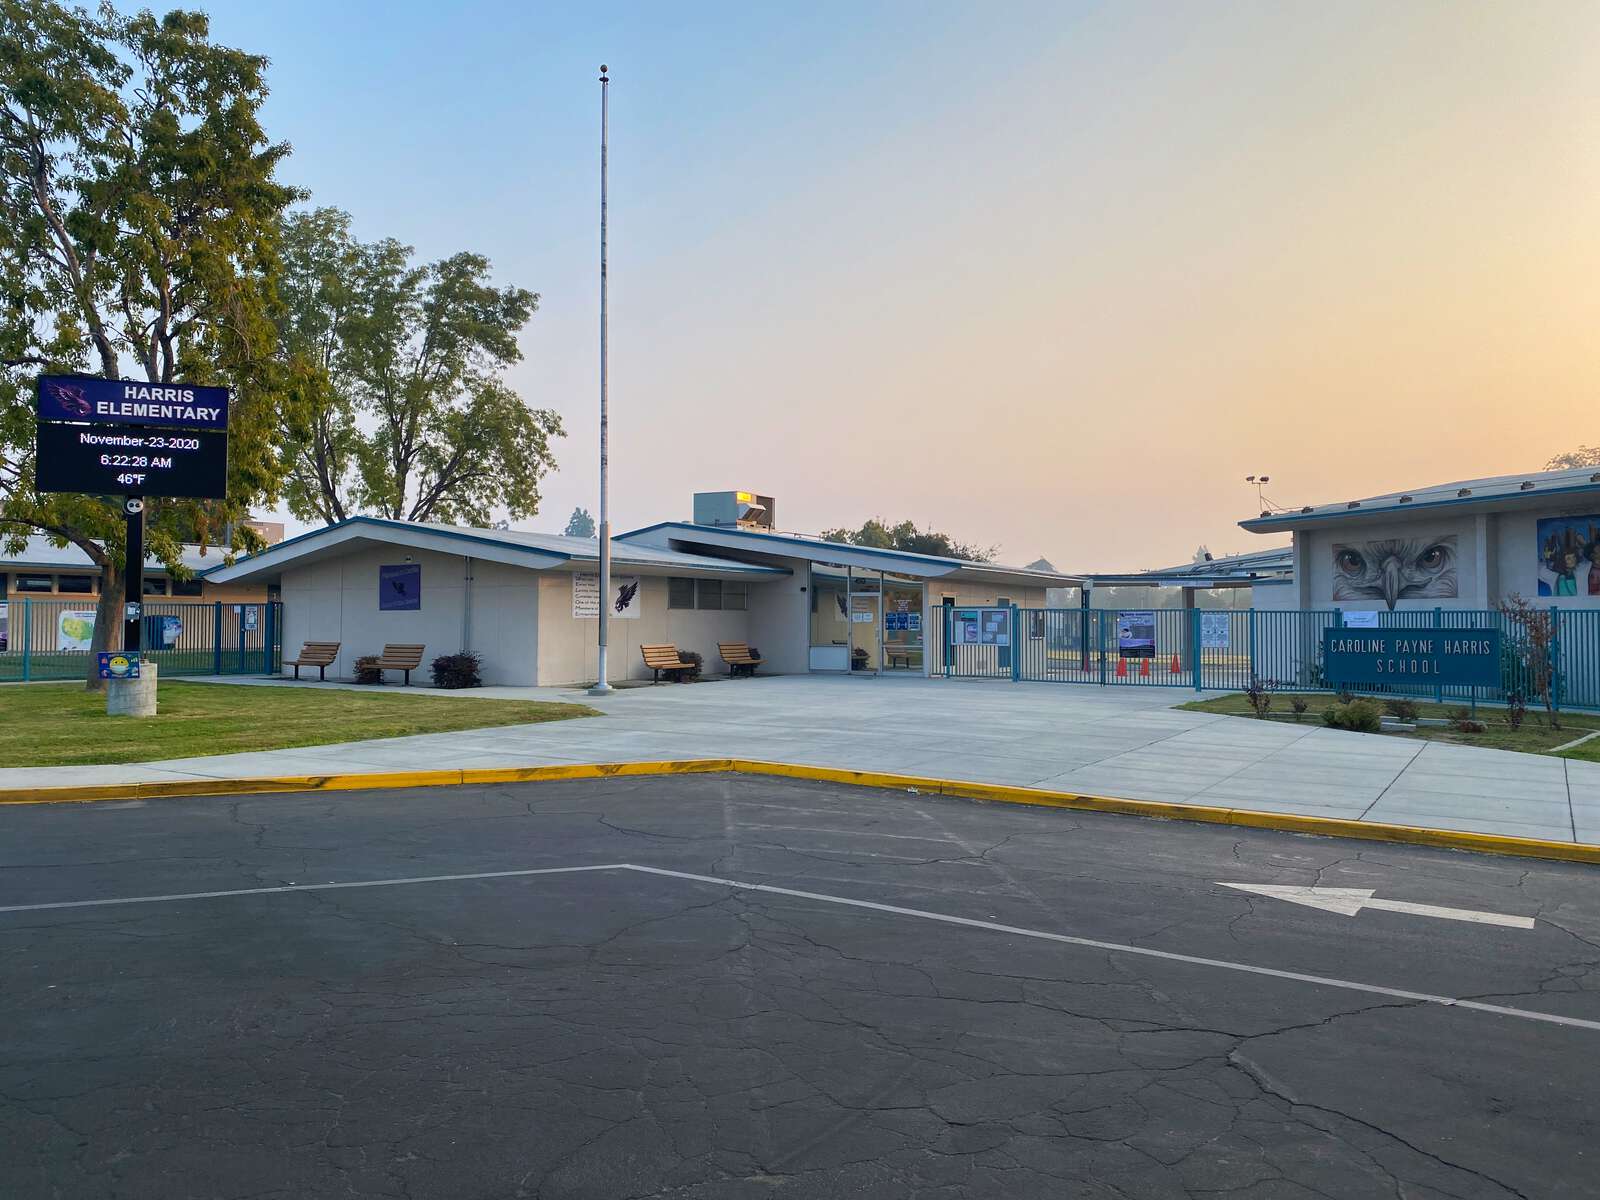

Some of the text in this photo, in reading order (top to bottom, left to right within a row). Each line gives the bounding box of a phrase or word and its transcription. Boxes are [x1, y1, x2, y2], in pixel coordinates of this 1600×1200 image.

[124, 386, 194, 402] HARRIS
[96, 401, 220, 420] ELEMENTARY
[80, 433, 199, 449] November-23-2020
[100, 454, 172, 468] 6:22:28 AM
[1331, 639, 1490, 654] CAROLINE PAYNE HARRIS
[1377, 659, 1440, 674] SCHOOL
